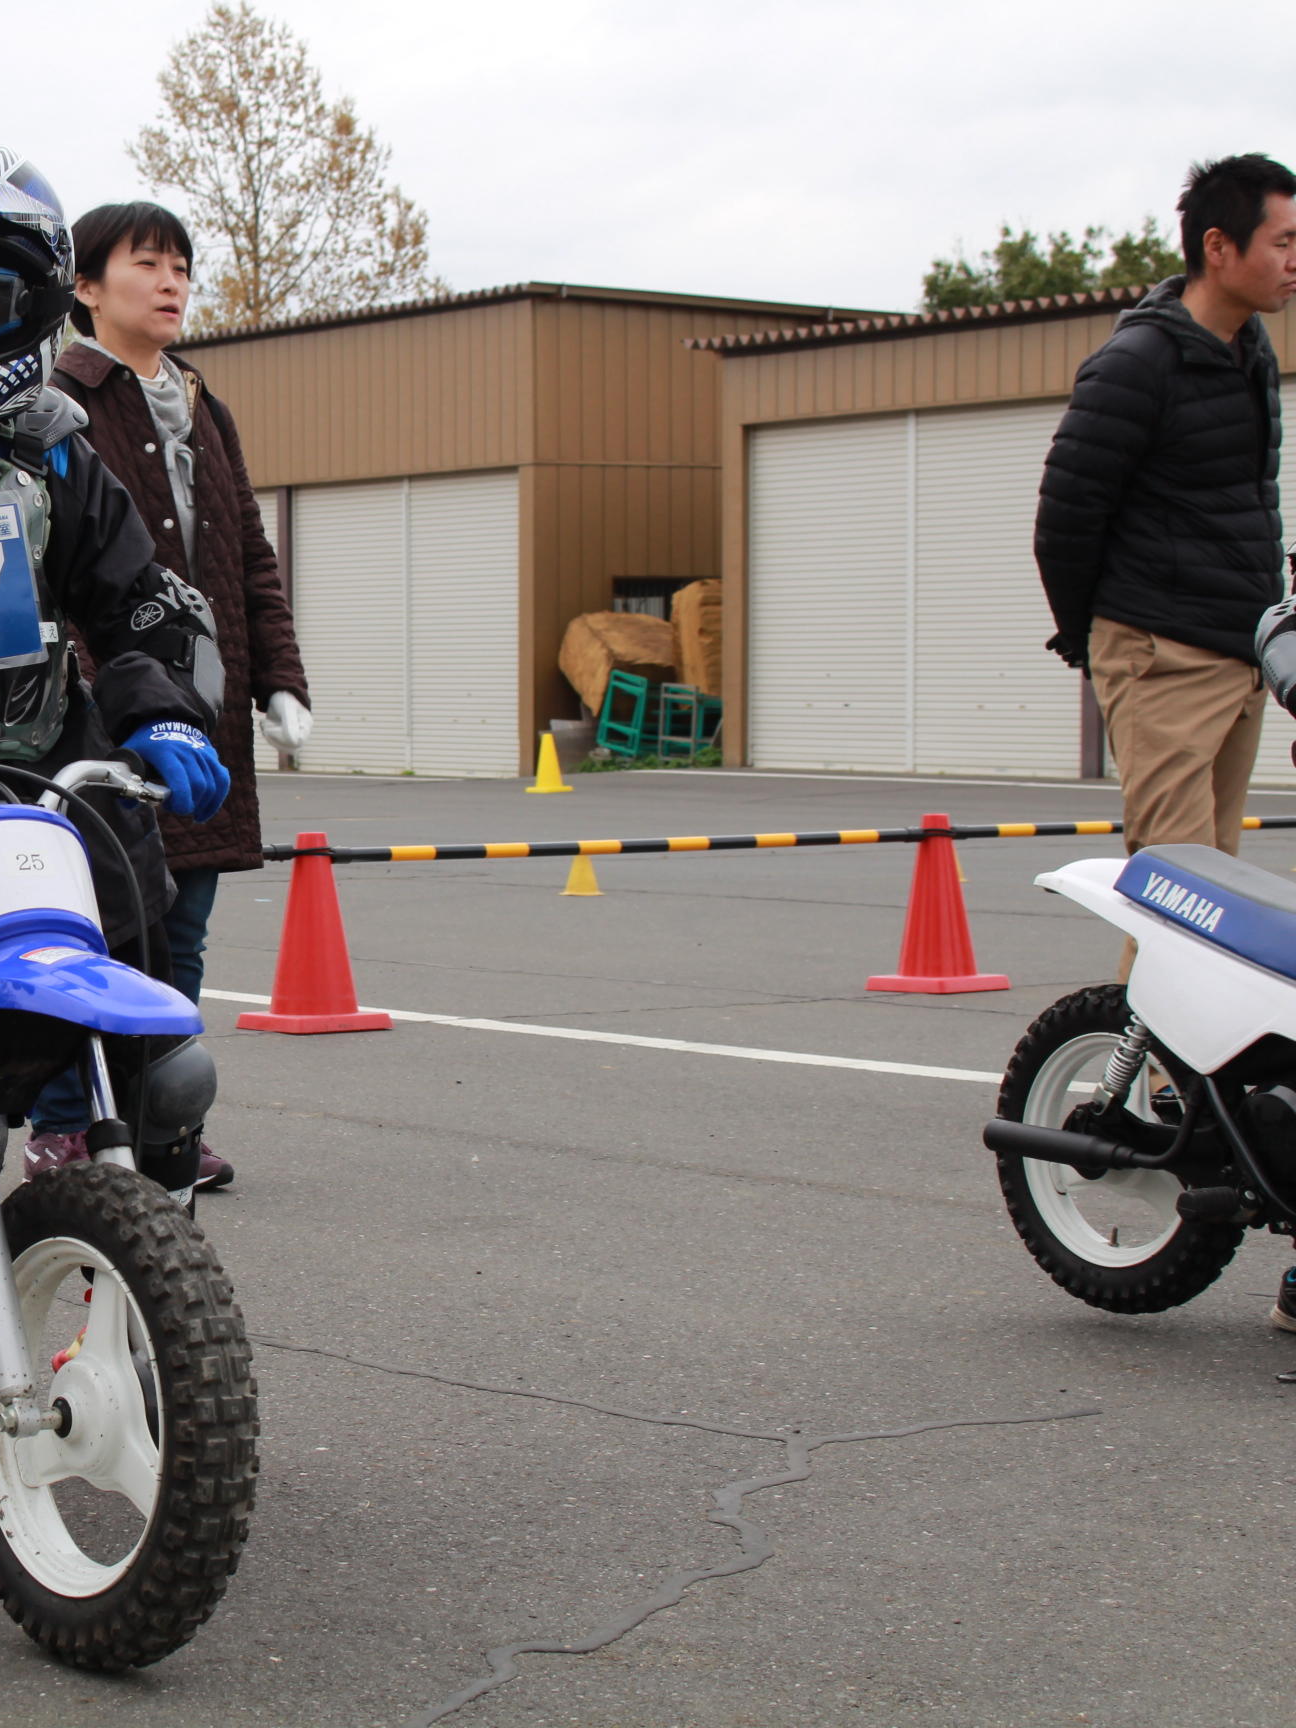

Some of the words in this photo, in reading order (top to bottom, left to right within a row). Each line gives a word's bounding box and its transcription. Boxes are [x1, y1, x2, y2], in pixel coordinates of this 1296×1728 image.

[151, 721, 192, 735] YAMAHA
[16, 853, 45, 871] 25
[1141, 871, 1225, 933] YAMAHA
